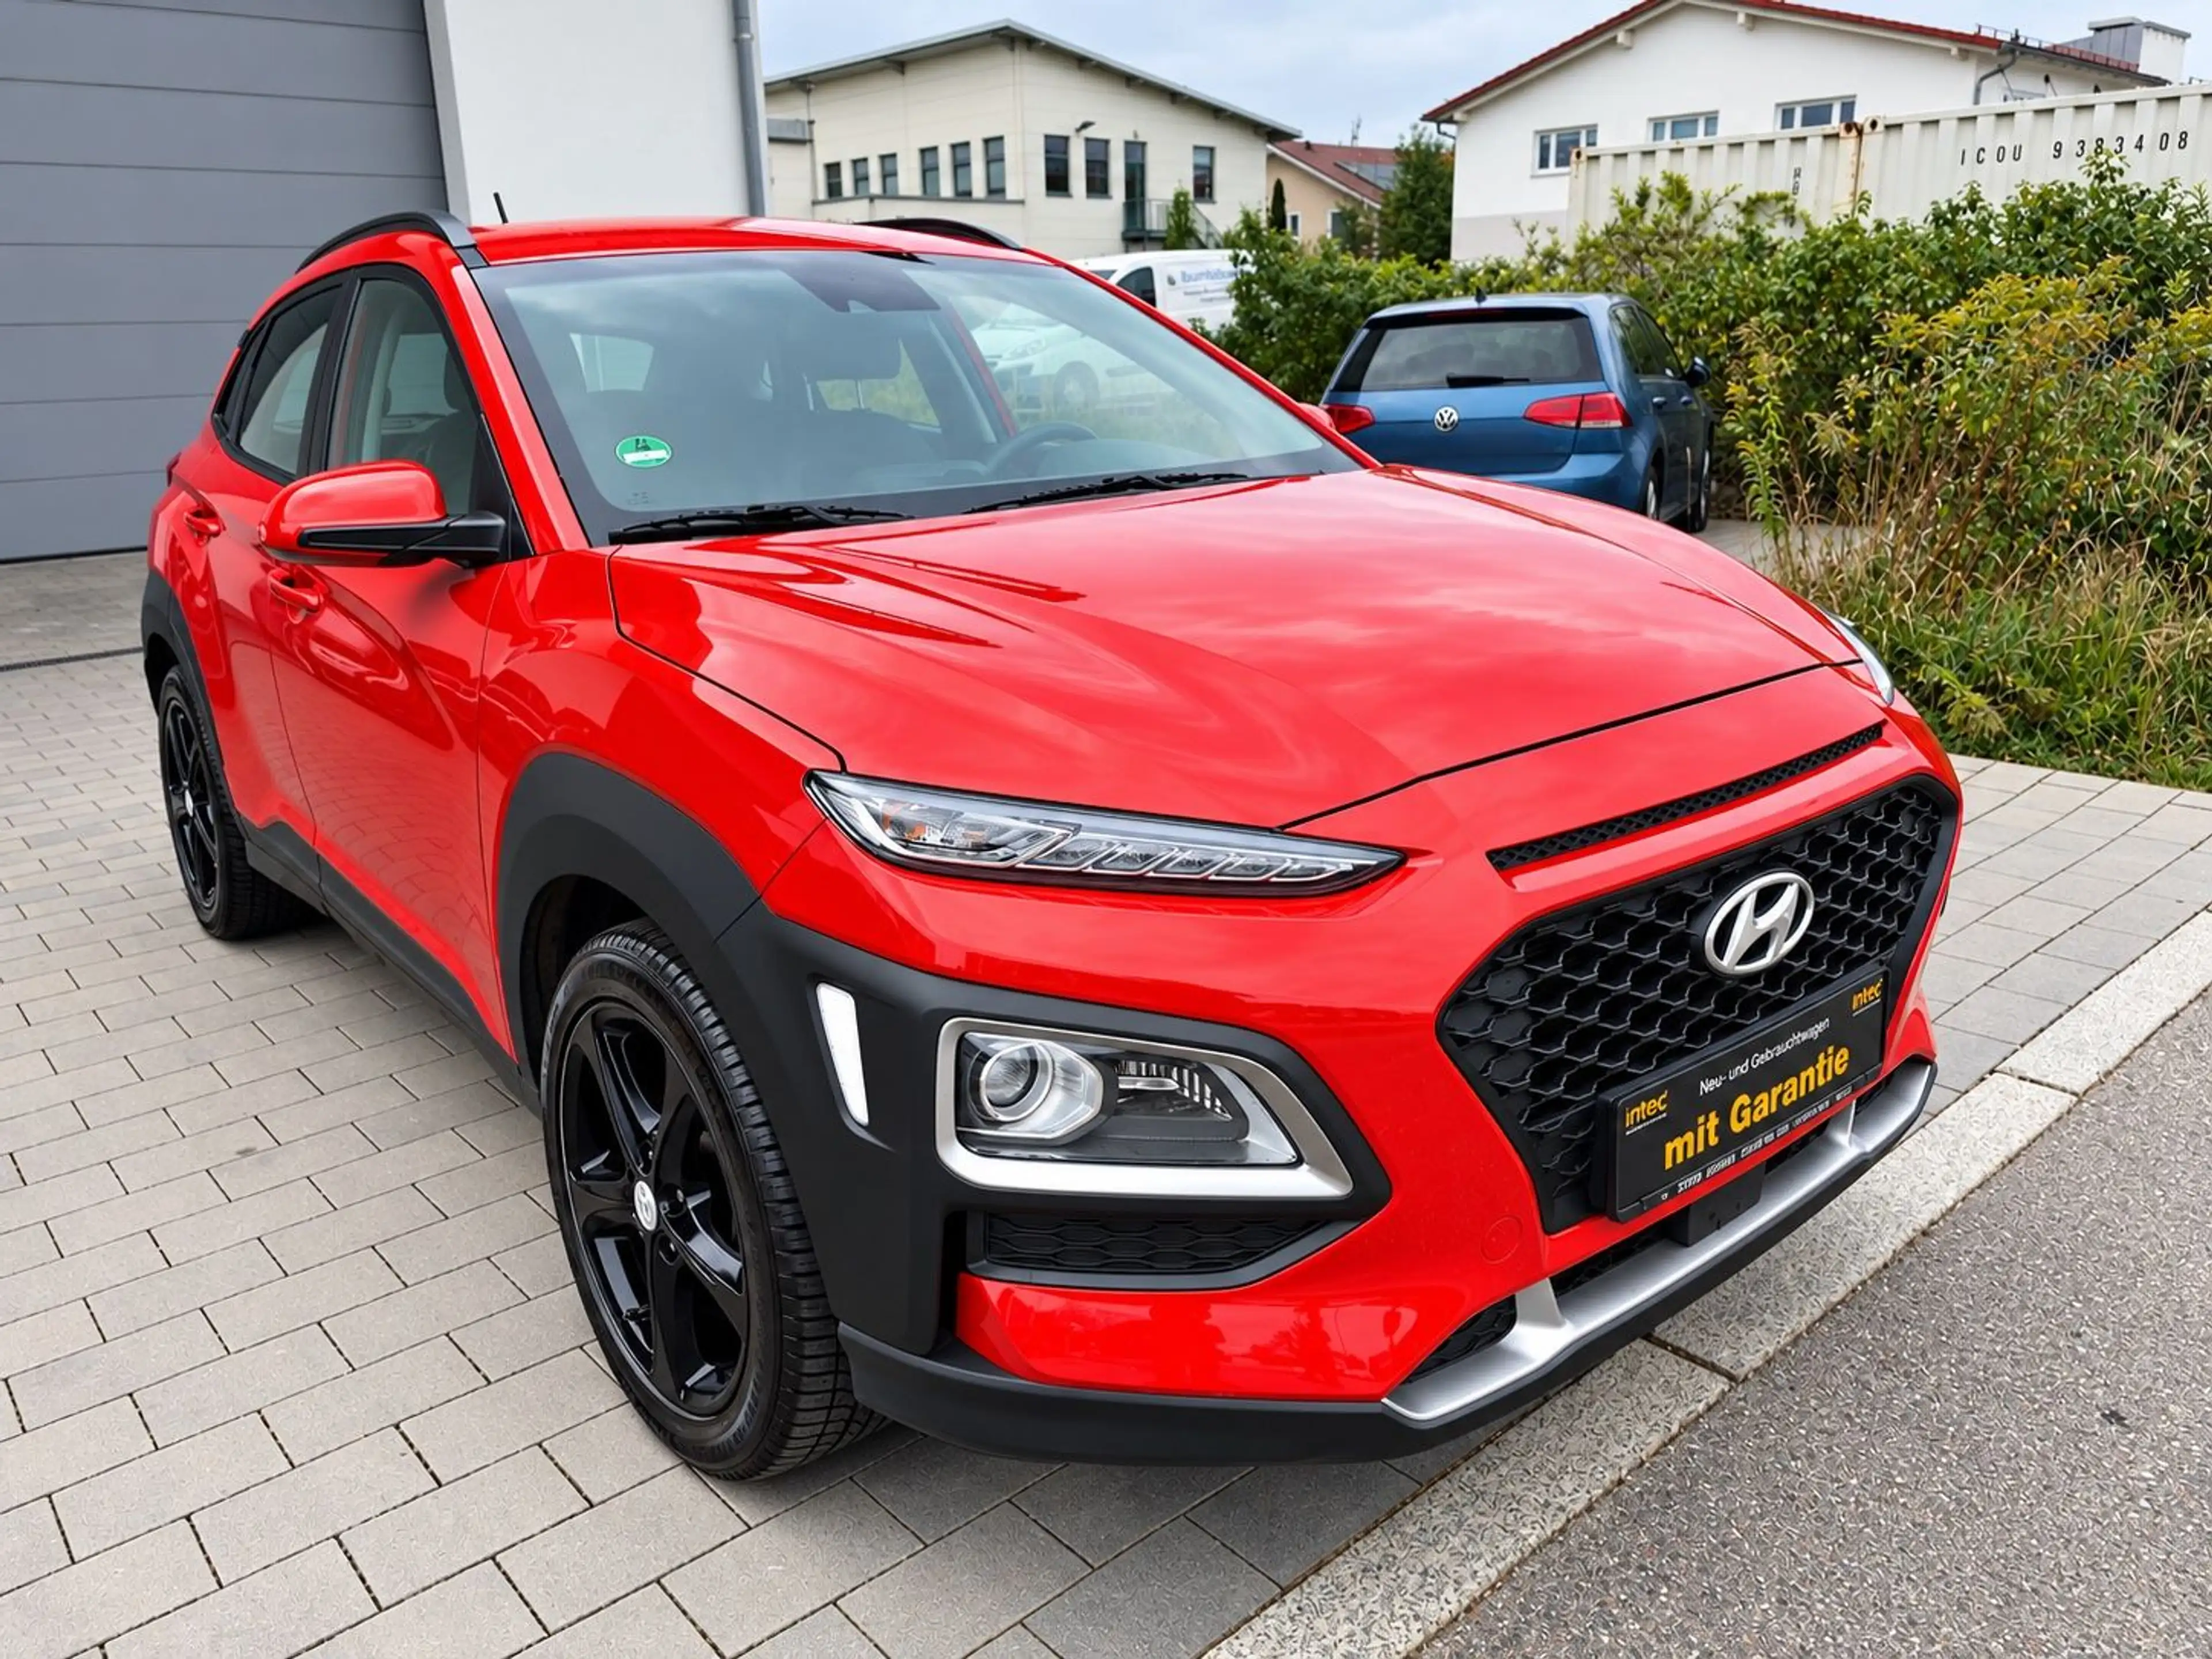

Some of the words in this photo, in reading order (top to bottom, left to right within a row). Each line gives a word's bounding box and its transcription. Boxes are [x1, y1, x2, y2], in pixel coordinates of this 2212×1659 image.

[1960, 143, 2022, 166] ICOU
[1851, 977, 1883, 1011] intec
[1699, 1075, 1726, 1095] Neu-
[1729, 1059, 1749, 1080] und
[1751, 1017, 1830, 1069] Gebrauchtwagen
[1624, 1089, 1668, 1127] intec
[1664, 1109, 1719, 1171] mit
[1730, 1044, 1849, 1133] Garantie
